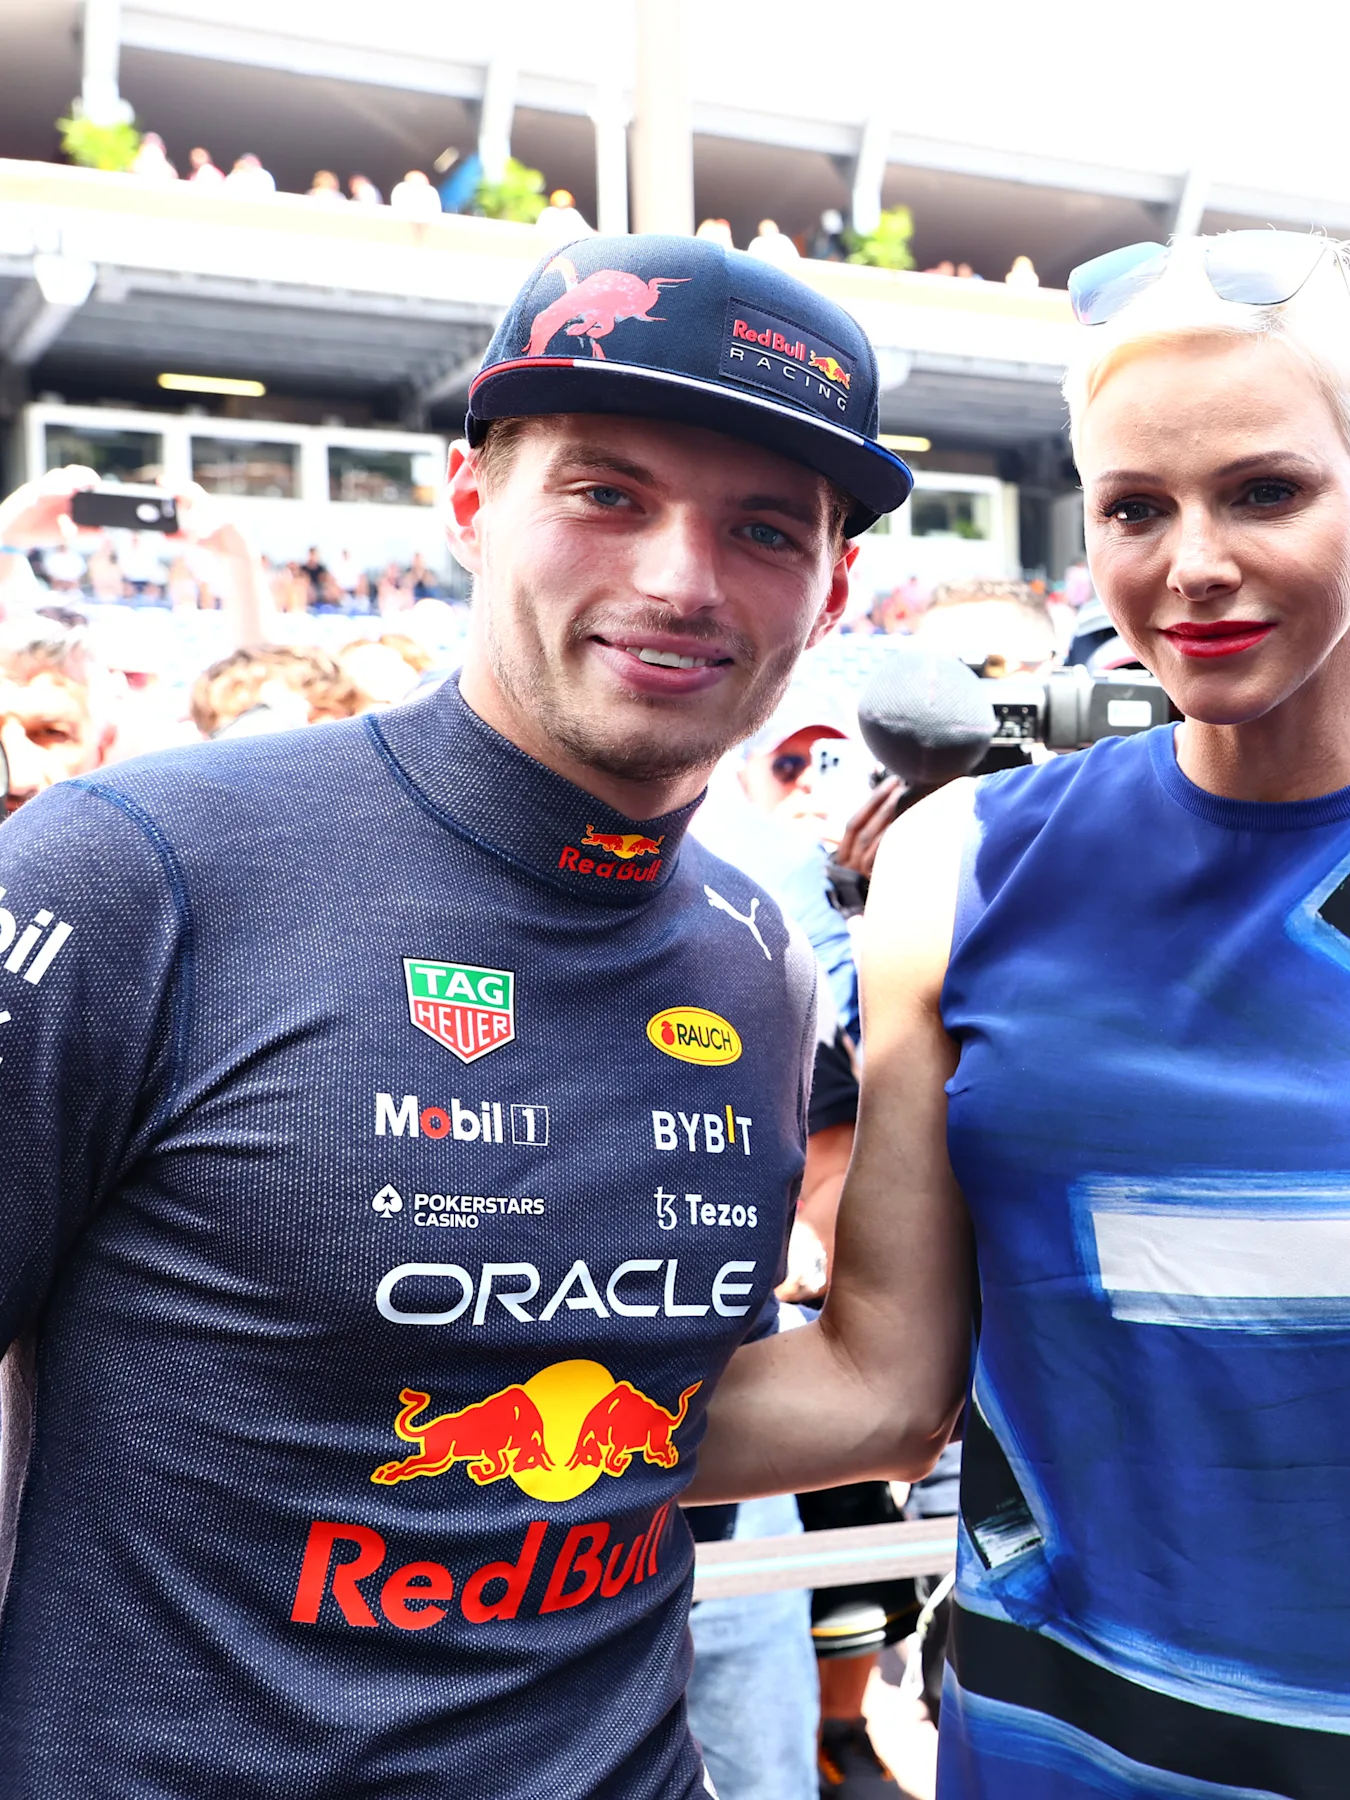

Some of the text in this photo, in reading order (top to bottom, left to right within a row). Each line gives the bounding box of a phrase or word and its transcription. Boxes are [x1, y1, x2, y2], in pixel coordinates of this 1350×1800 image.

[733, 319, 806, 362] Red Bull
[730, 347, 847, 412] RACING
[558, 845, 662, 882] Red Bull
[414, 966, 504, 1006] TAG
[417, 1003, 508, 1055] HEUER
[676, 1023, 733, 1053] RAUCH
[375, 1092, 504, 1143] Mobil
[652, 1104, 753, 1156] BYBIT
[413, 1212, 479, 1229] CASINO
[414, 1193, 545, 1215] POKERSTARS
[685, 1193, 758, 1228] Tezos
[375, 1258, 758, 1326] ORACLE
[290, 1501, 671, 1631] Red Bull
